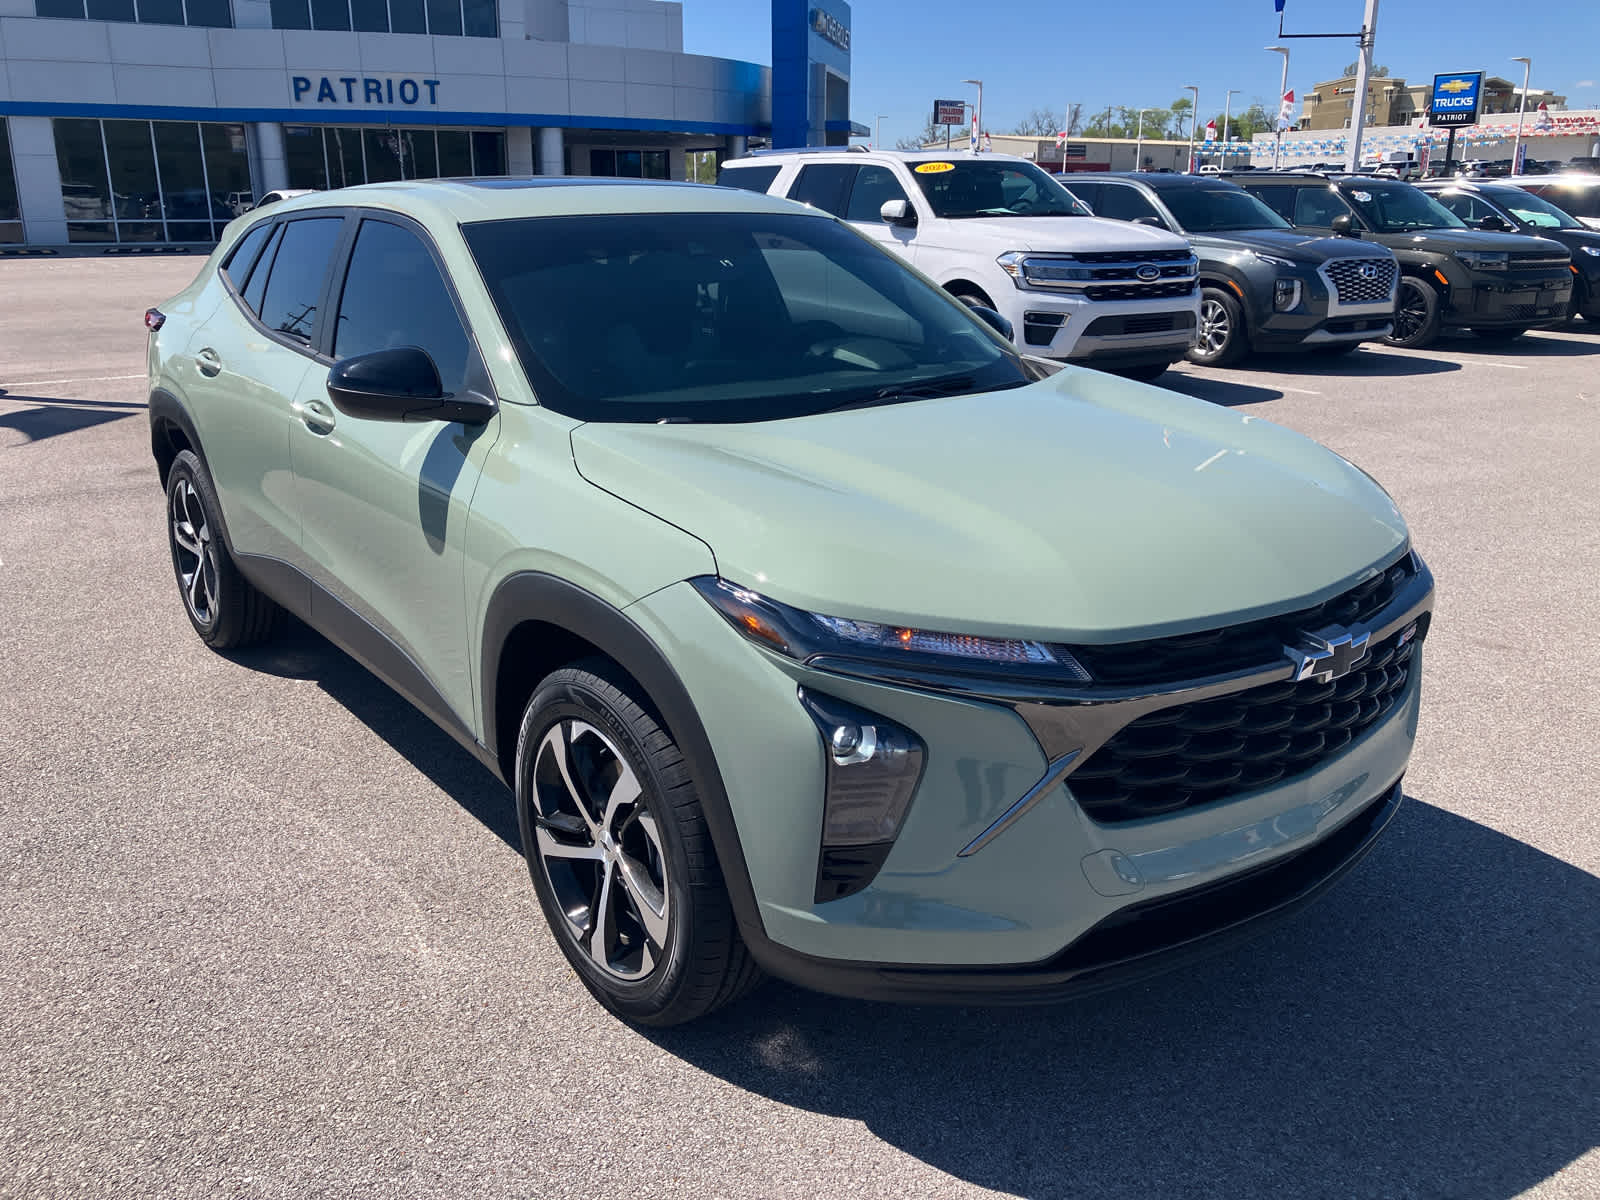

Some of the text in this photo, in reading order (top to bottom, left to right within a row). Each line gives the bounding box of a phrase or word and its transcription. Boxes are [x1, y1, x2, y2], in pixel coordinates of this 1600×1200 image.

[292, 76, 440, 105] PATRIOT
[1434, 97, 1474, 107] TRUCKS
[923, 164, 948, 172] 2024
